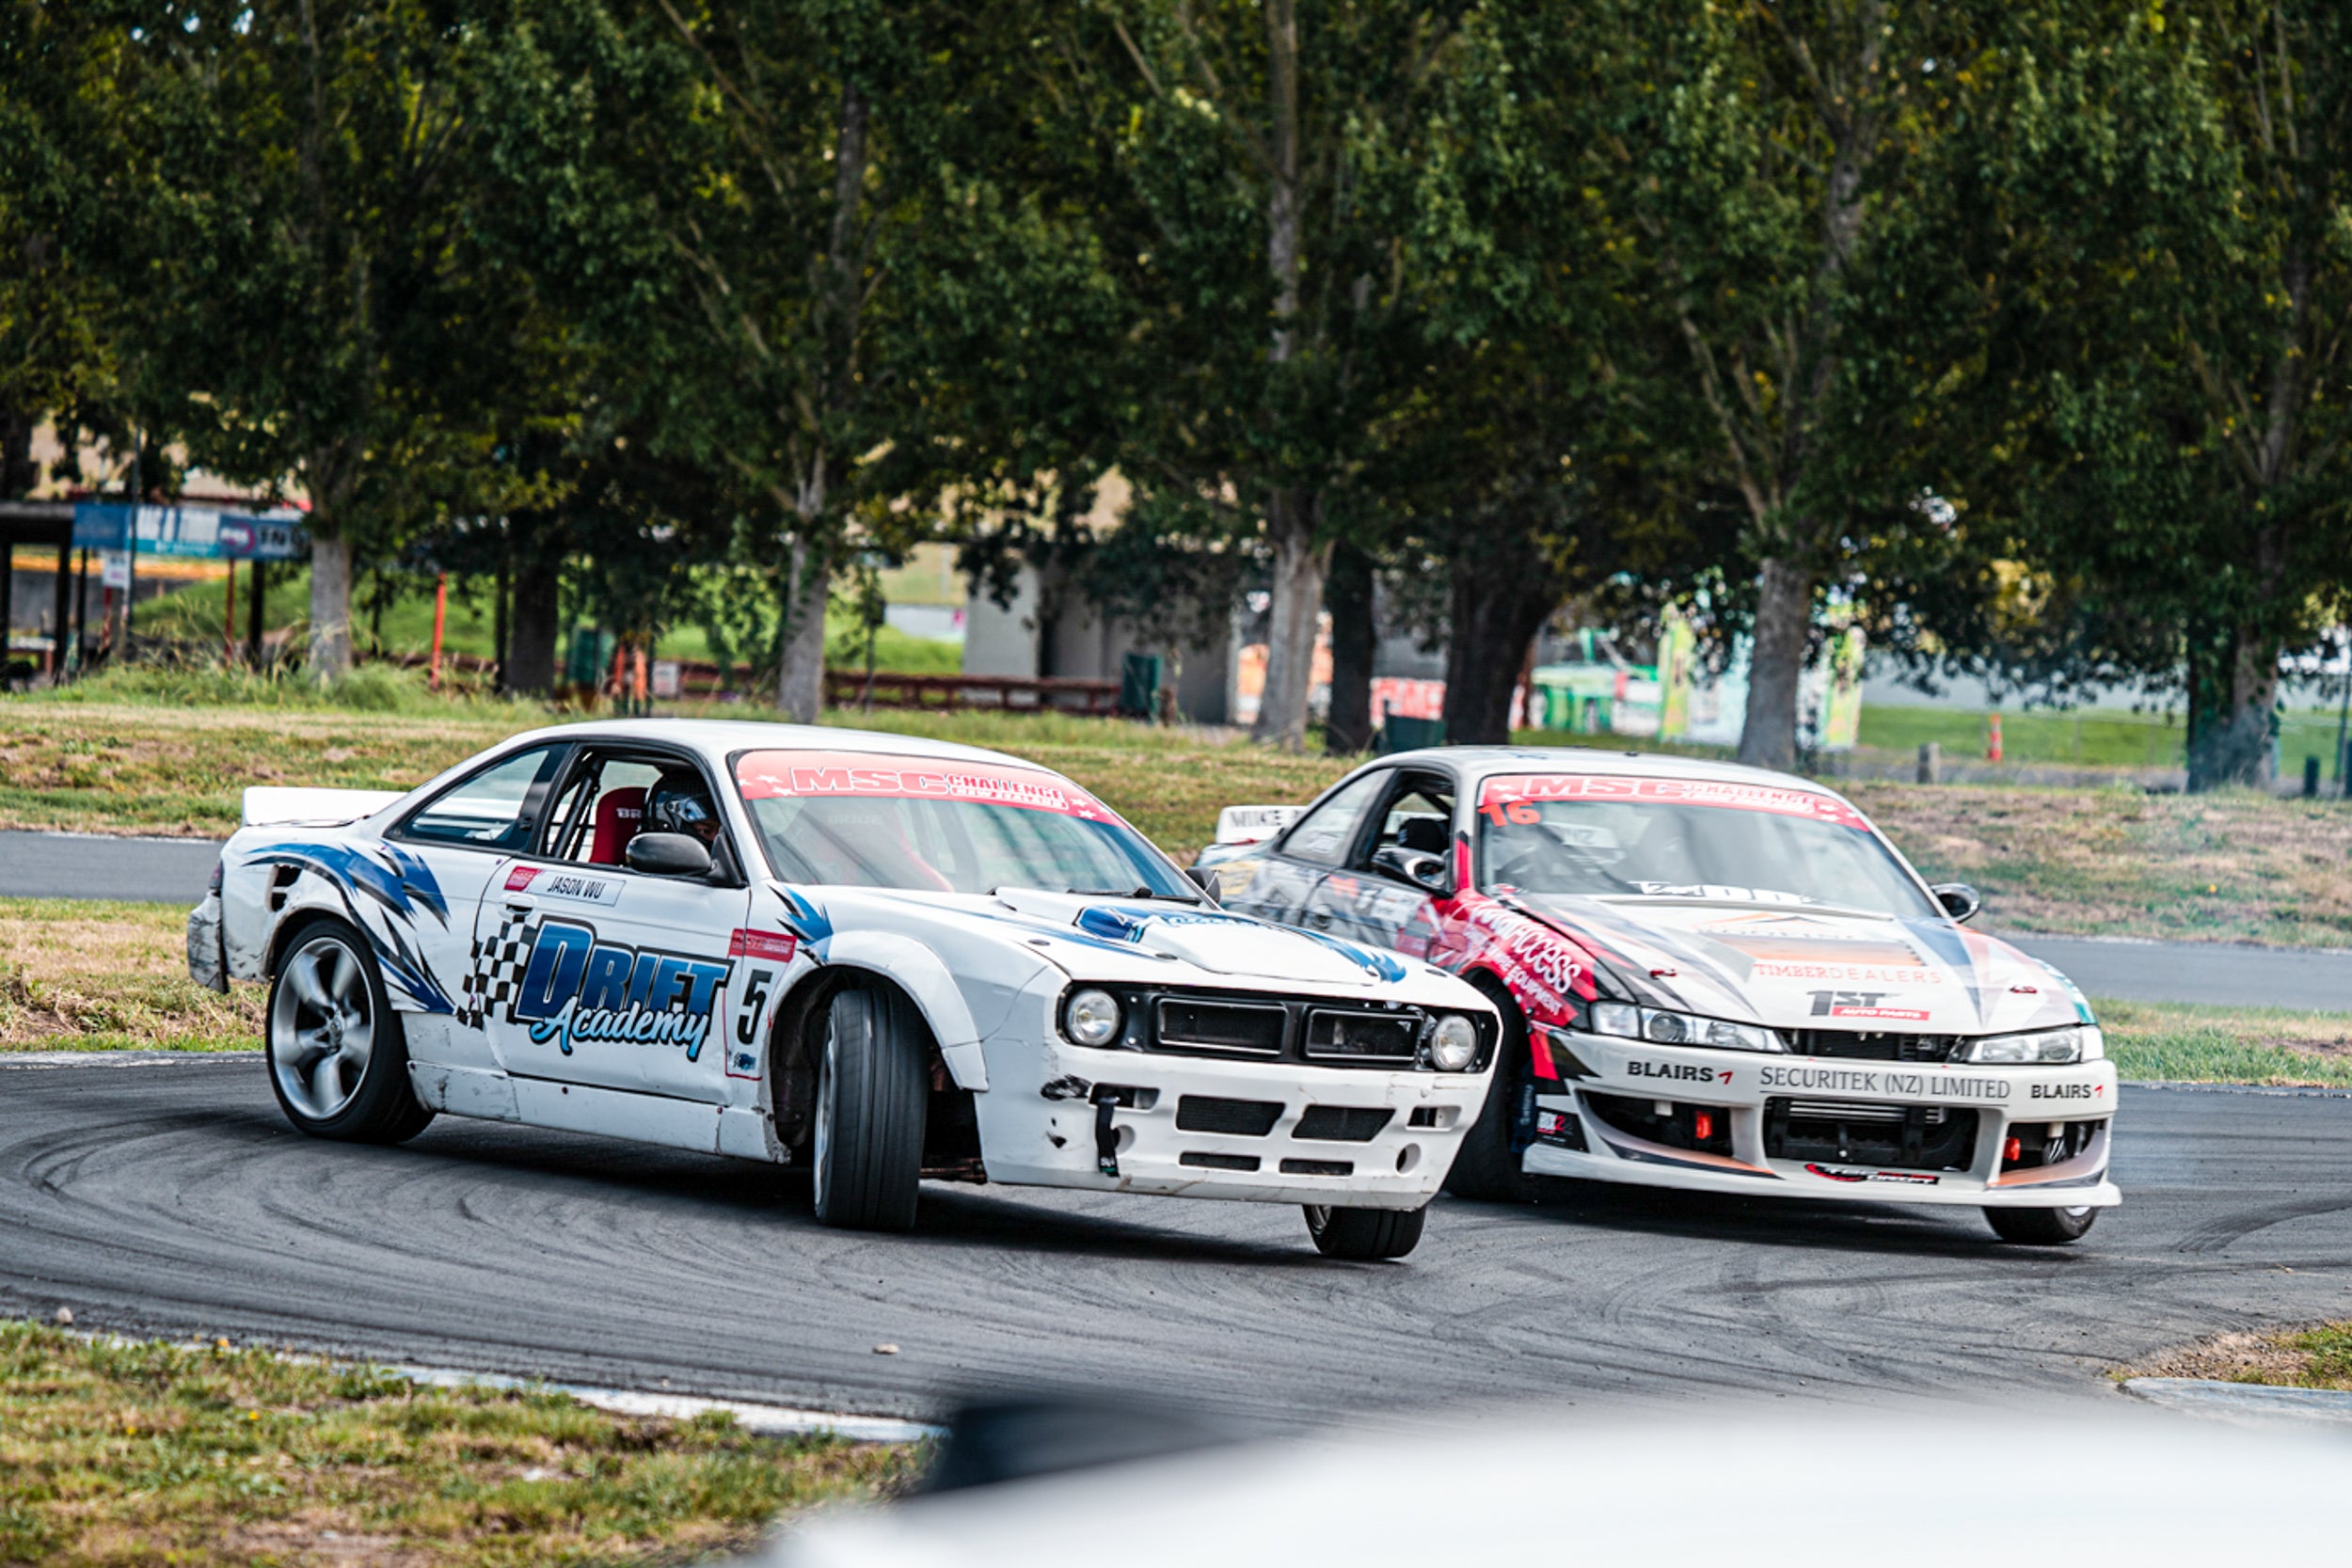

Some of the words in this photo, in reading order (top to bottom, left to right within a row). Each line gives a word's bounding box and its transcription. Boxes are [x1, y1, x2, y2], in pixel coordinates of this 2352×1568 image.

[790, 767, 947, 796] MSC
[946, 772, 1064, 800] CHALLENGE
[1522, 777, 1690, 799] MSC
[1477, 800, 1542, 828] 16
[547, 876, 585, 895] JASON
[582, 880, 607, 900] WU
[515, 915, 735, 1022] DRIFT
[737, 968, 773, 1046] 5
[529, 995, 709, 1062] Academy
[1627, 1061, 1714, 1083] BLAIRS
[1759, 1066, 1879, 1092] SECURITEK
[1884, 1072, 1925, 1097] (NZ)
[1931, 1076, 2011, 1100] LIMITED
[2030, 1084, 2091, 1100] BLAIRS
